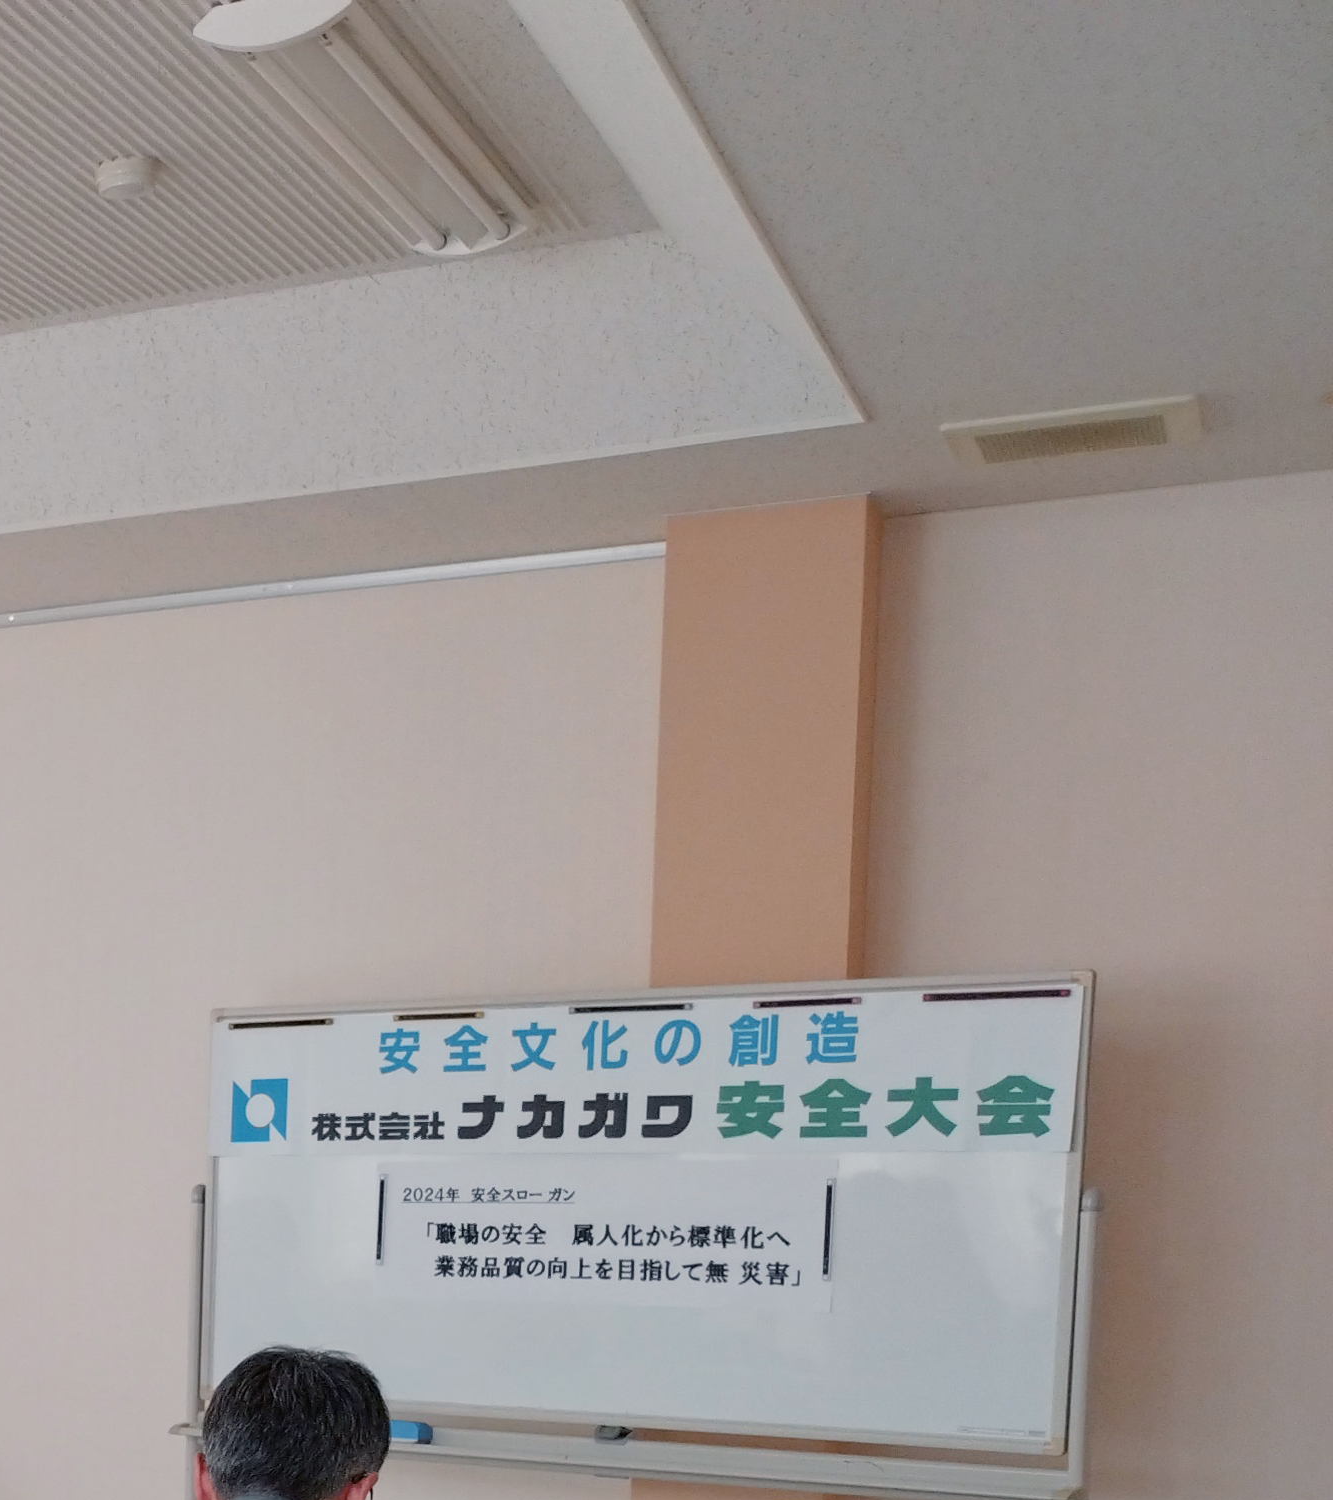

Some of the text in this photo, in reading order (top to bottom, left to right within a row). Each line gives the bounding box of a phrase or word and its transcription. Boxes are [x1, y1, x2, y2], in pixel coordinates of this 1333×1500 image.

[379, 1011, 859, 1074] 安全文化の創造
[716, 1075, 1055, 1138] 安全大会
[403, 1187, 460, 1202] 2024年
